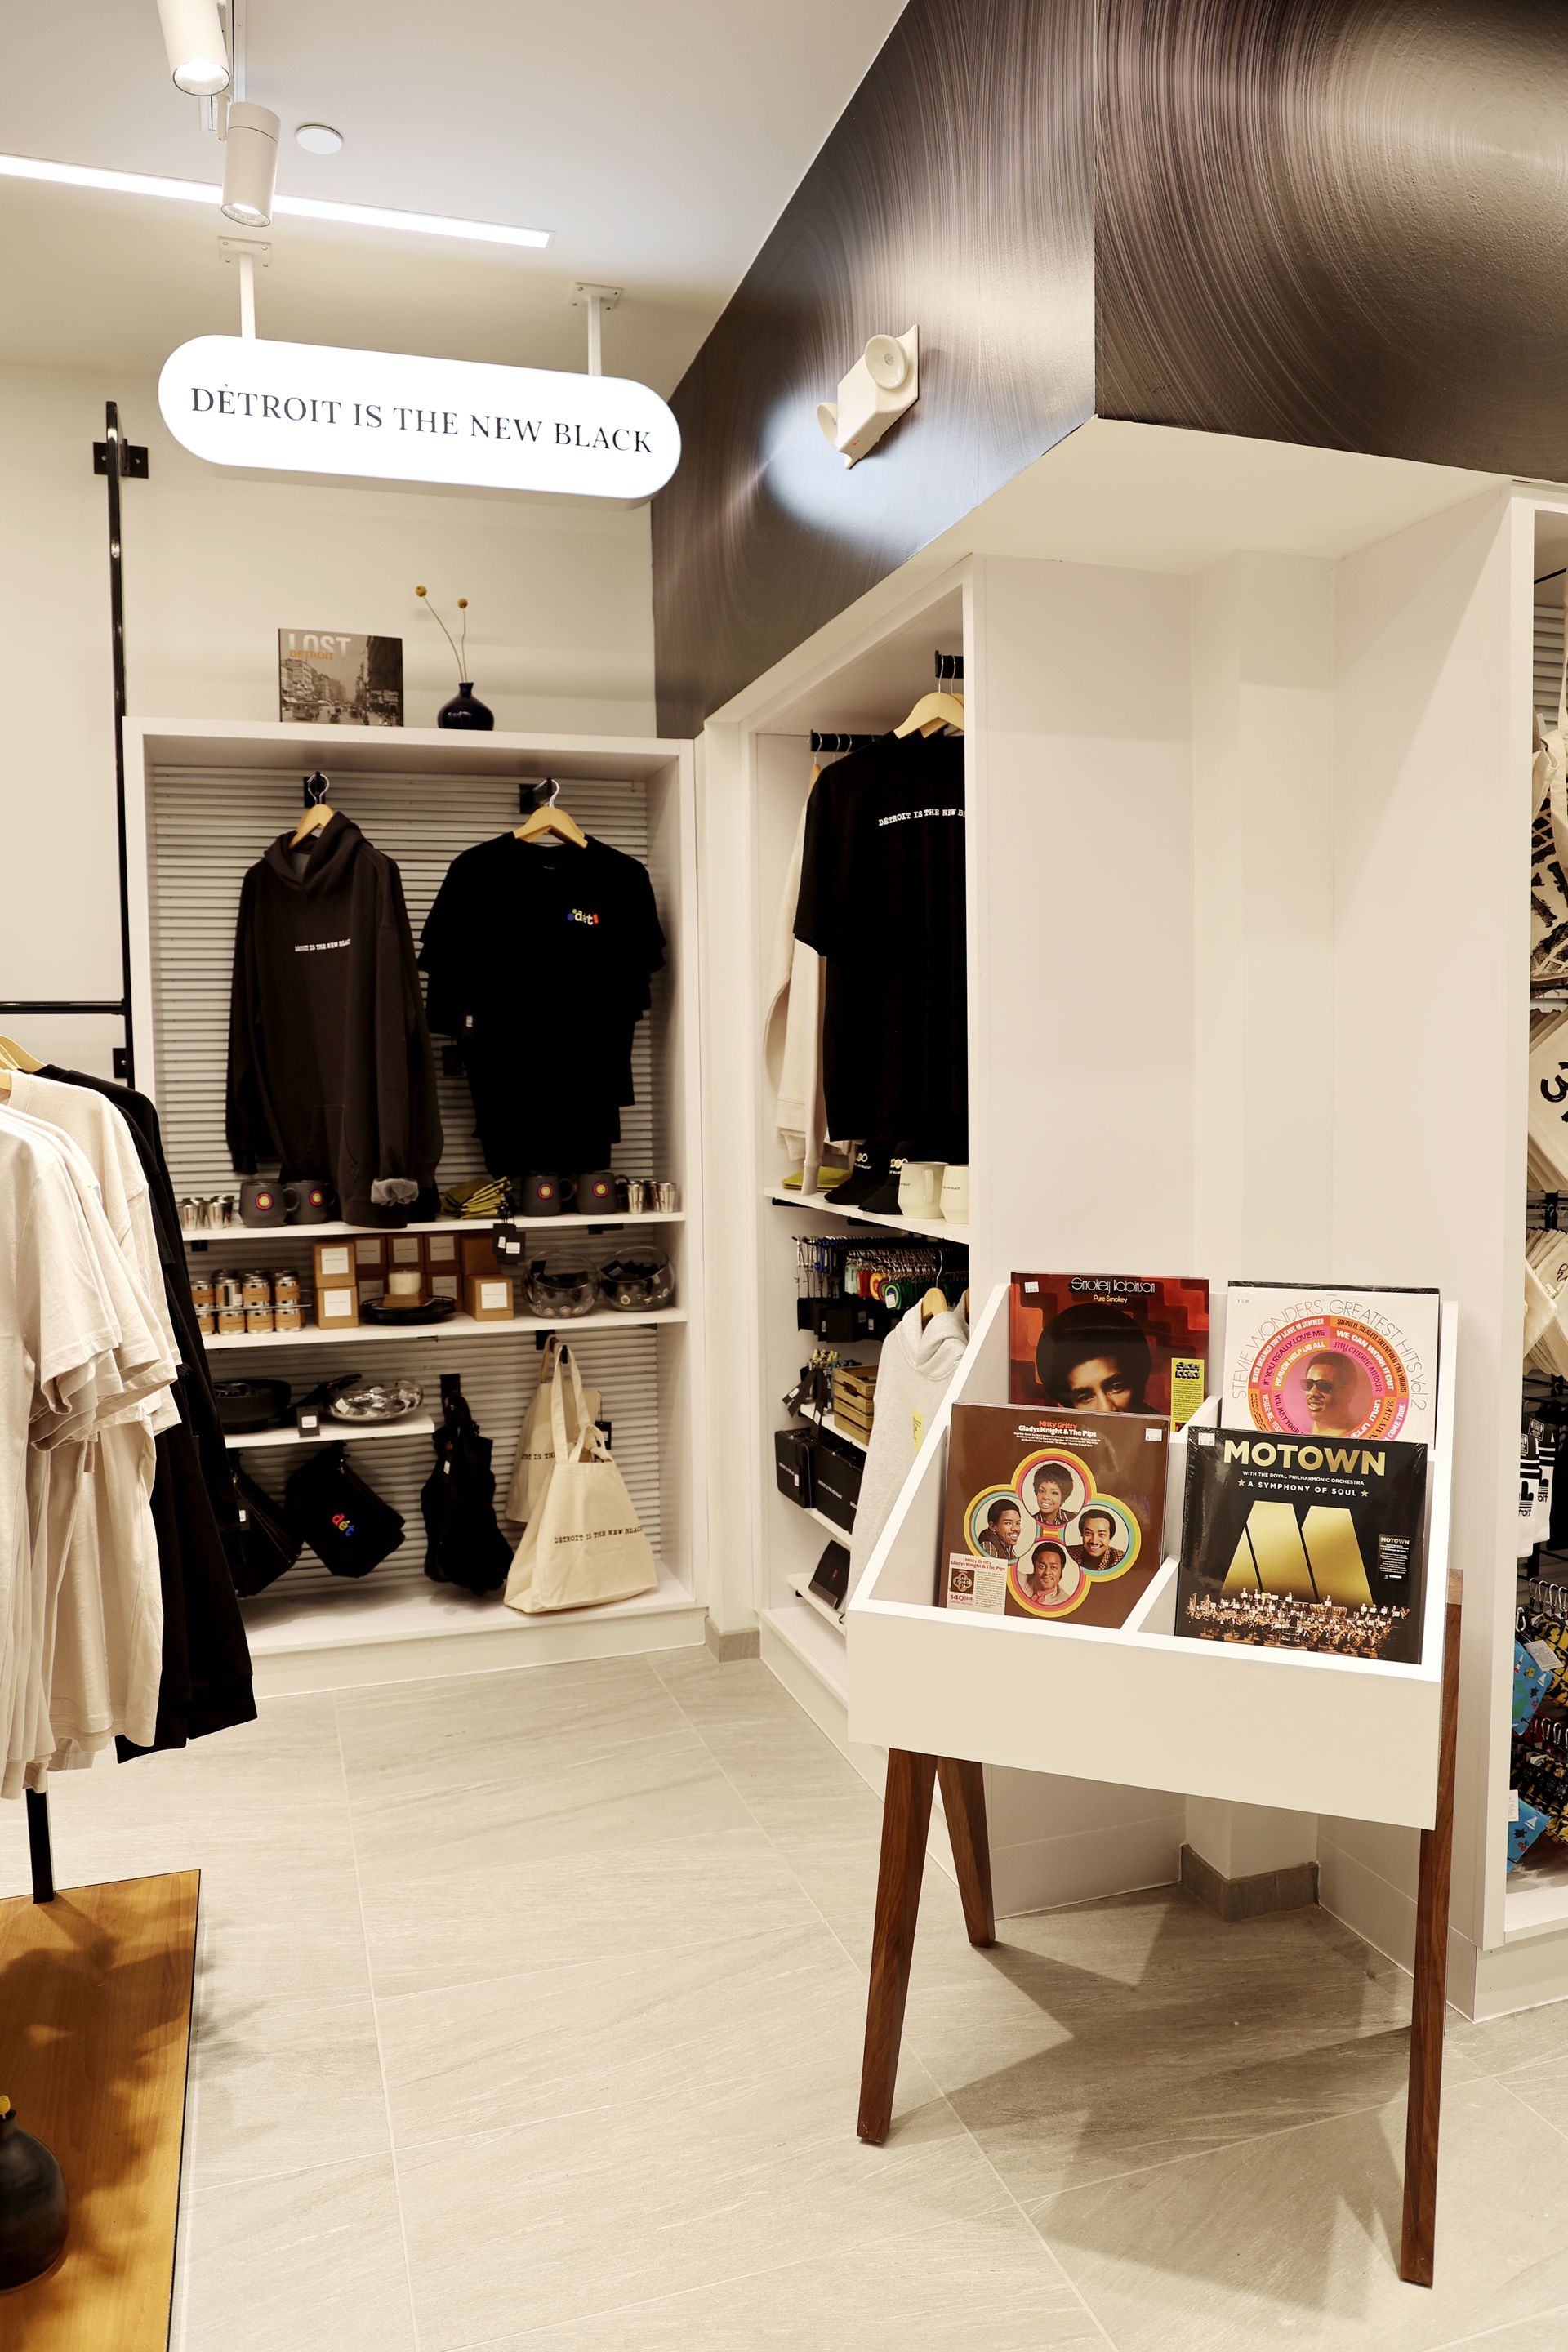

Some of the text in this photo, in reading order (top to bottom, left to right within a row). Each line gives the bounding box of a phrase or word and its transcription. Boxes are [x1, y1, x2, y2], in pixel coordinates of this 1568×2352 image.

[353, 403, 382, 428] IS
[393, 406, 459, 436] THE
[470, 414, 543, 444] NEW
[554, 422, 653, 454] BLACK
[288, 633, 351, 656] LOST
[913, 810, 924, 818] IS
[924, 808, 940, 817] THE
[942, 808, 957, 817] NEW
[1071, 1277, 1156, 1294] Smokey Robinson
[1106, 1295, 1128, 1304] Smokey
[1232, 1350, 1255, 1399] STEVIE
[1329, 1299, 1403, 1340] GREATEST
[1395, 1339, 1423, 1373] HITS
[1410, 1399, 1427, 1410] 2
[1265, 1362, 1276, 1378] YOU
[1273, 1341, 1294, 1363] REALLY
[1293, 1332, 1311, 1344] LOVE
[1275, 1341, 1326, 1387] HEAVEN HELP US ALL
[1336, 1330, 1395, 1391] WE CAN WORK IT OUT
[1348, 1346, 1372, 1367] CHERIE
[1039, 1420, 1056, 1428] Nitty
[1277, 1406, 1289, 1421] MET
[1285, 1420, 1300, 1434] YOUR
[1376, 1421, 1387, 1433] MY
[1383, 1401, 1394, 1421] LIFE
[1387, 1404, 1406, 1437] COME TRUE
[1018, 1424, 1040, 1434] Gladys
[1040, 1426, 1063, 1435] Knight
[1082, 1430, 1097, 1438] Pips
[1223, 1439, 1387, 1477] MOTOWN
[1258, 1481, 1311, 1492] SYMPHONY
[1331, 1488, 1357, 1497] SOUL
[1288, 1474, 1330, 1483] PHILHARMONIC
[625, 1526, 643, 1535] BLAC
